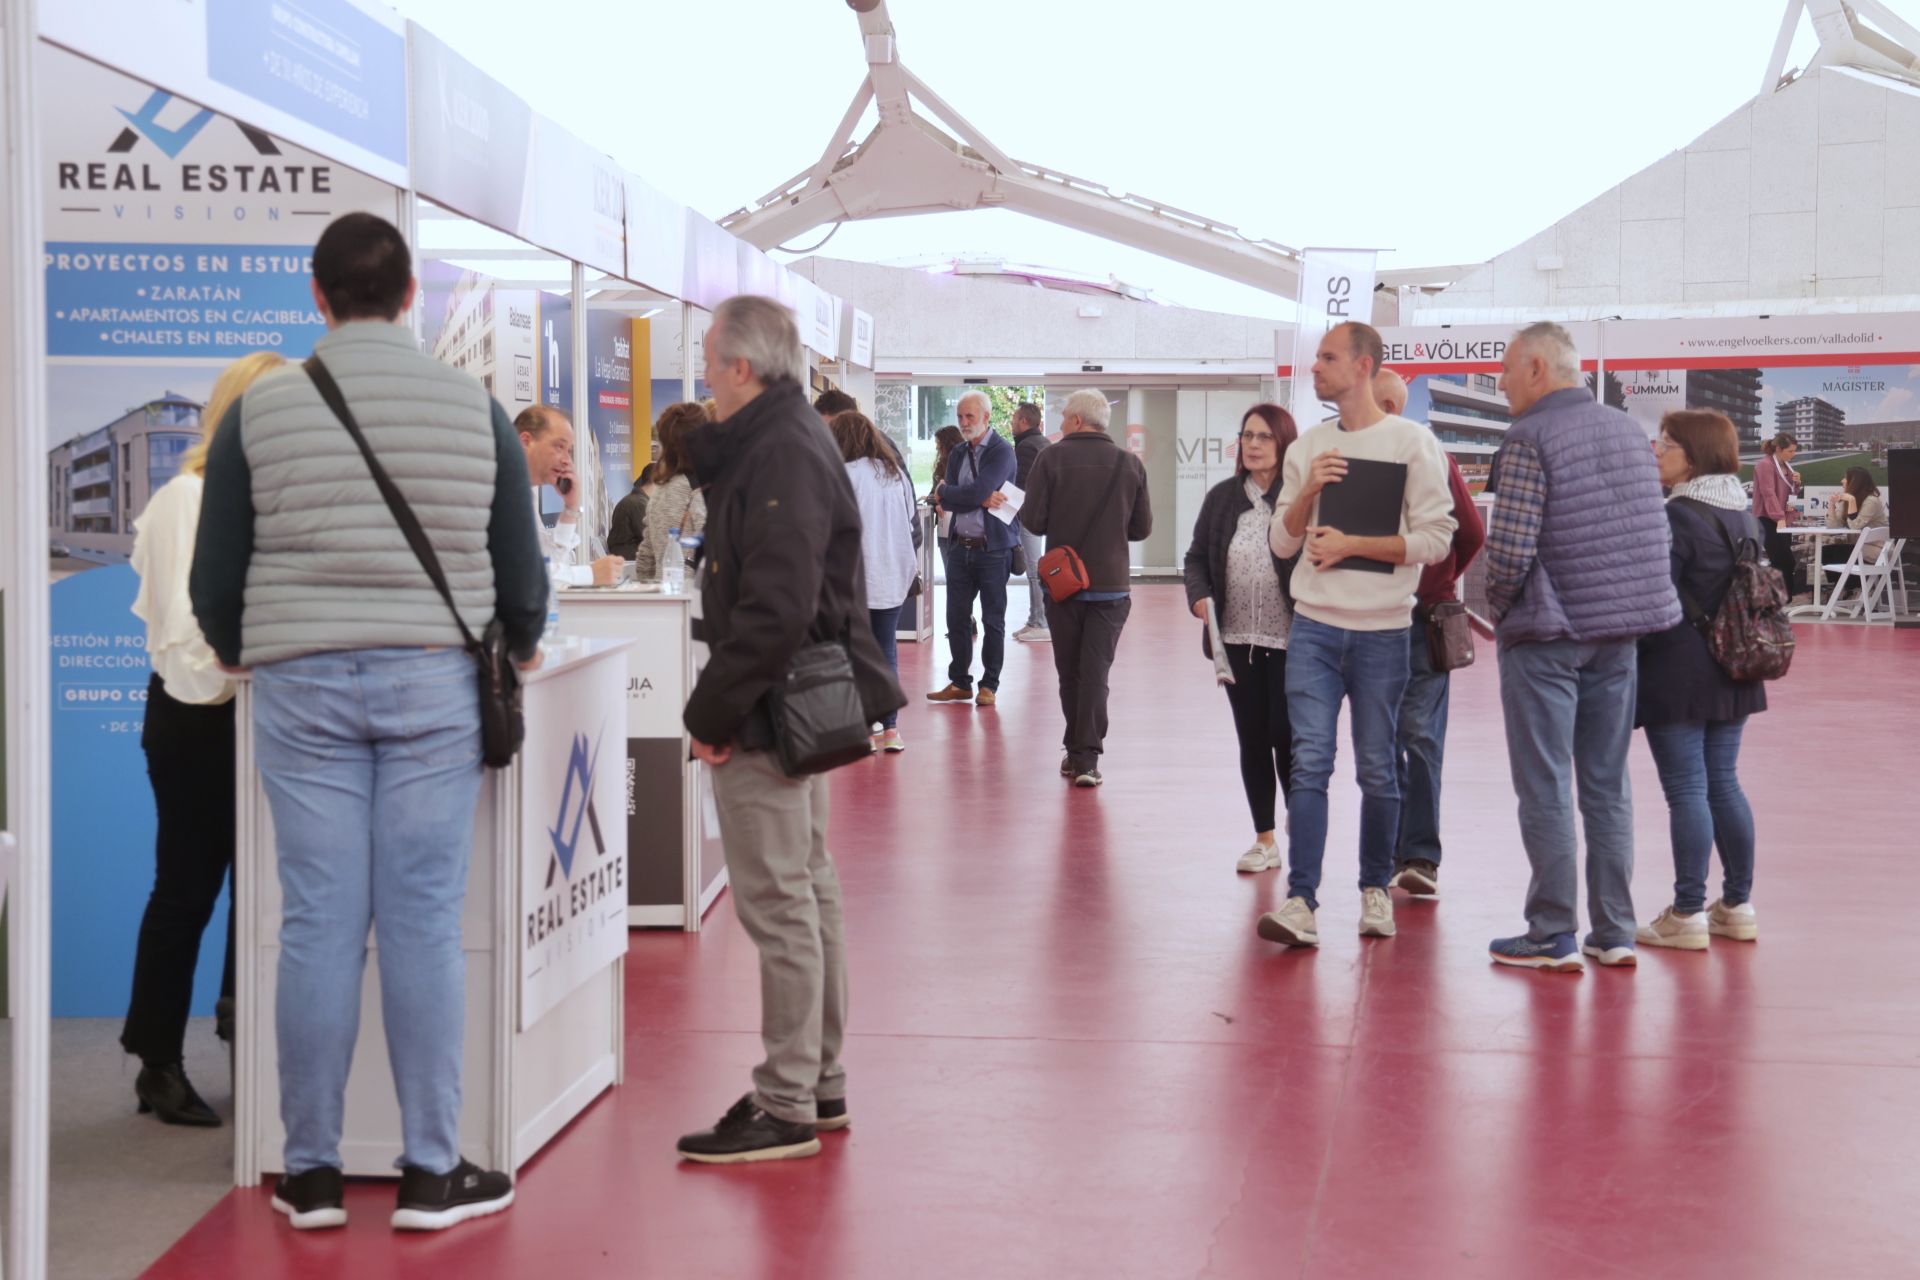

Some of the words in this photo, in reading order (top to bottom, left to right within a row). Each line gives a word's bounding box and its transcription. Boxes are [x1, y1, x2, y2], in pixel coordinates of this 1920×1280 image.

[59, 162, 161, 191] REAL
[182, 165, 331, 193] ESTATE
[113, 205, 280, 221] VISION
[44, 254, 185, 273] PROYECTOS
[197, 256, 228, 273] EN
[151, 284, 241, 302] ZARATÁN
[70, 308, 199, 324] APARTAMENTOS
[205, 309, 227, 324] EN
[232, 309, 326, 326] C/ACIBELAS
[112, 330, 183, 345] CHALETS
[188, 331, 211, 345] EN
[216, 331, 283, 346] RENEDO
[1688, 333, 1874, 350] www.engelvoelkers.com/valladolid
[1625, 384, 1679, 396] SUMMUM
[1822, 381, 1886, 392] MAGISTER
[60, 653, 146, 668] DIRECCIÓN
[65, 689, 122, 701] GRUPO
[527, 894, 564, 950] REAL
[571, 856, 622, 918] ESTATE
